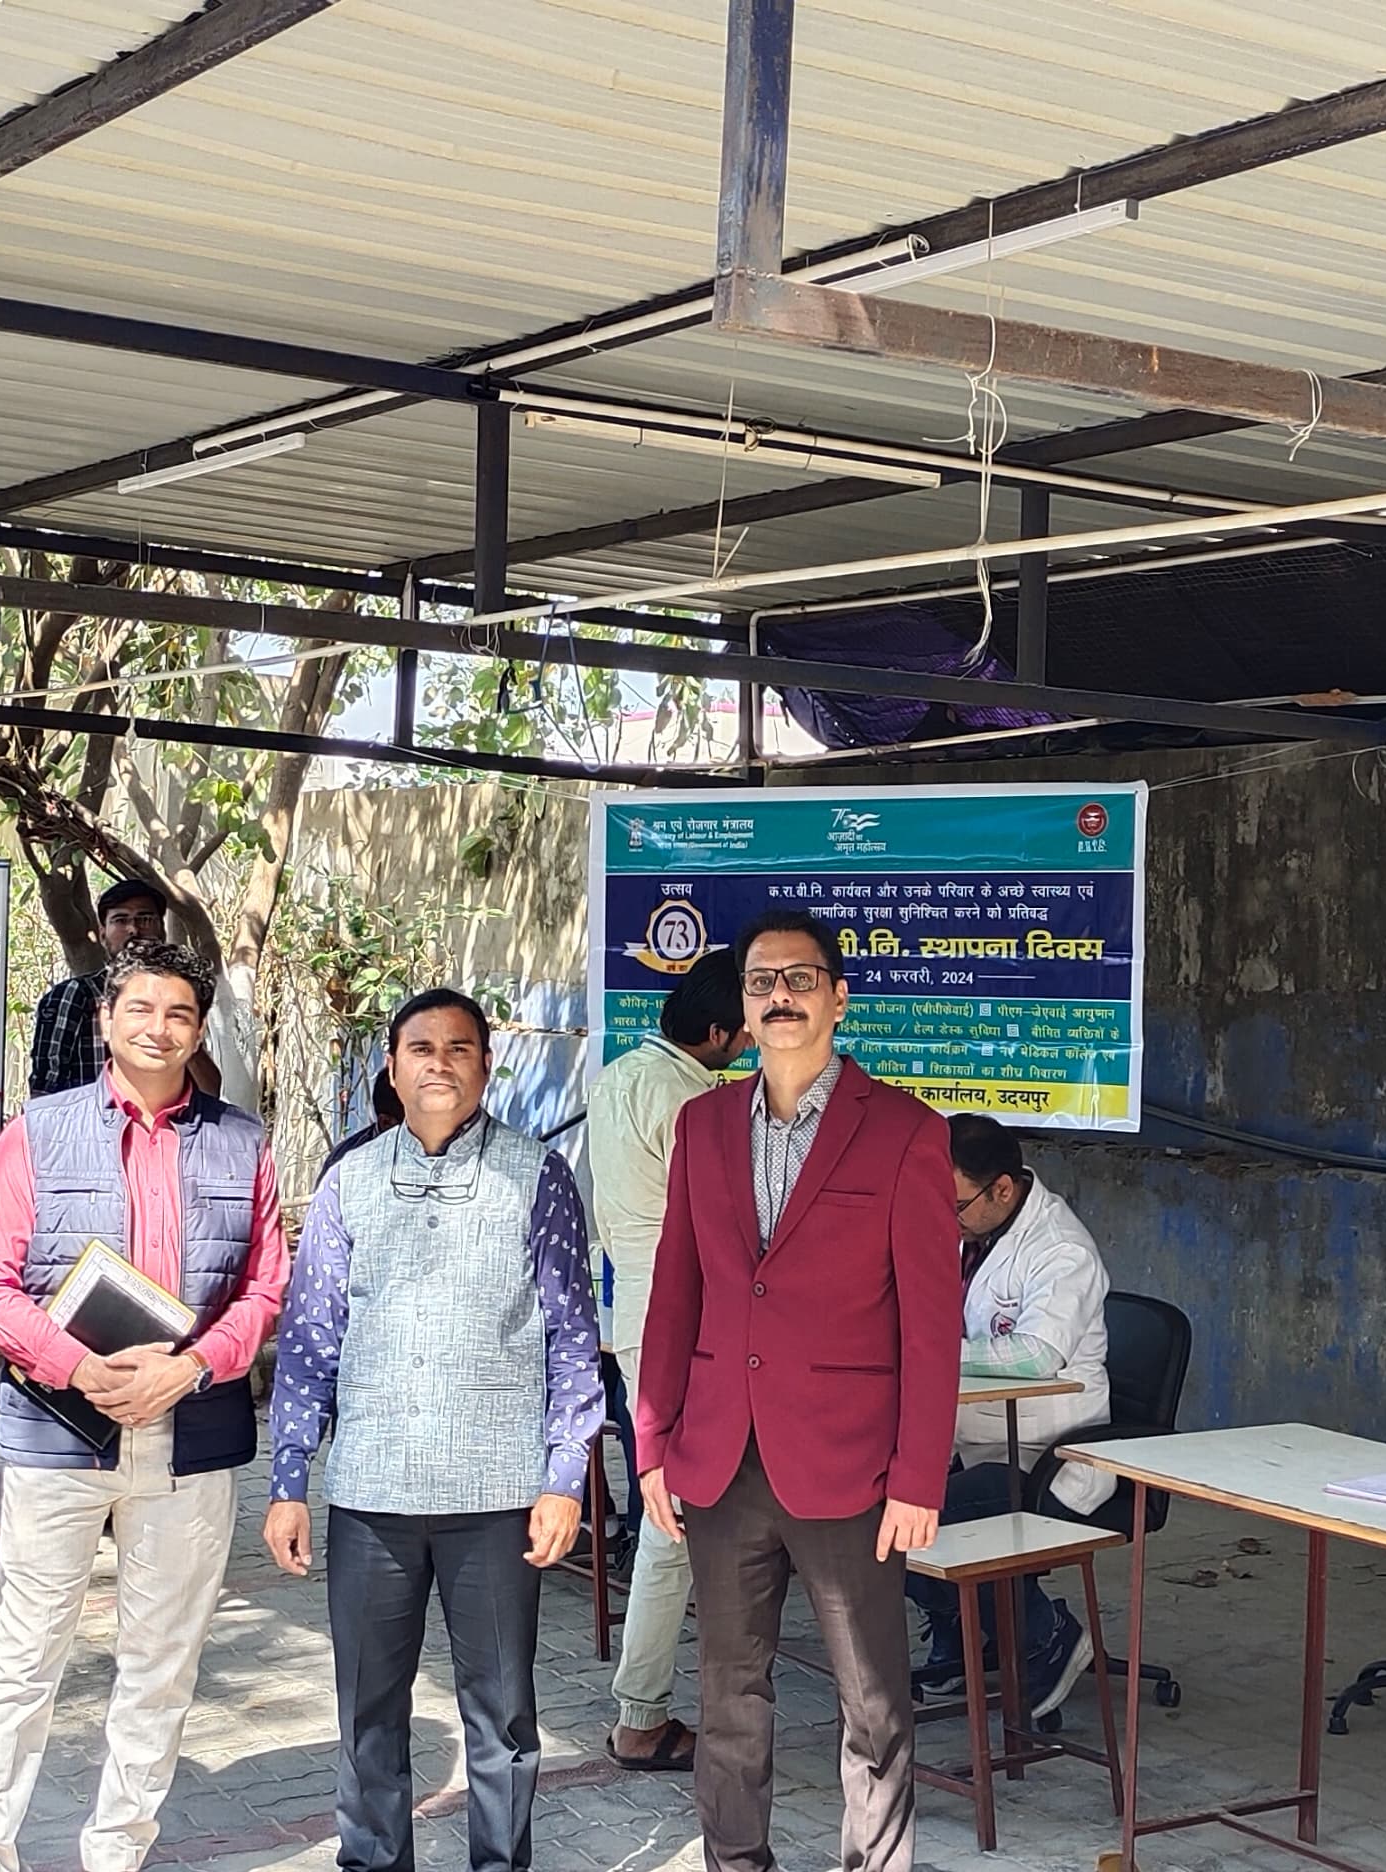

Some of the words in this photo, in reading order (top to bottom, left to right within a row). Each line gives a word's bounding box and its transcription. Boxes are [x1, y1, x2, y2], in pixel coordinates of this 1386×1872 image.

[660, 882, 693, 897] उत्सव
[877, 880, 899, 898] और
[904, 881, 932, 898] उनके
[938, 881, 974, 898] परिवार
[981, 881, 992, 898] के
[997, 881, 1025, 899] अच्छे
[1031, 885, 1071, 899] स्वास्थ्य
[1077, 880, 1094, 899] एवं
[809, 905, 857, 920] सामाजिक
[863, 907, 893, 924] सुरक्षा
[898, 905, 948, 923] सुनिश्चित
[954, 904, 980, 920] करने
[987, 904, 1002, 920] को
[663, 919, 690, 951] 73
[918, 937, 1019, 960] स्थापना
[1025, 929, 1105, 961] दिवस
[865, 970, 882, 983] 24
[942, 971, 974, 985] 2024
[920, 1081, 991, 1108] कार्यालय,
[996, 1088, 1051, 1112] उदयपुर
